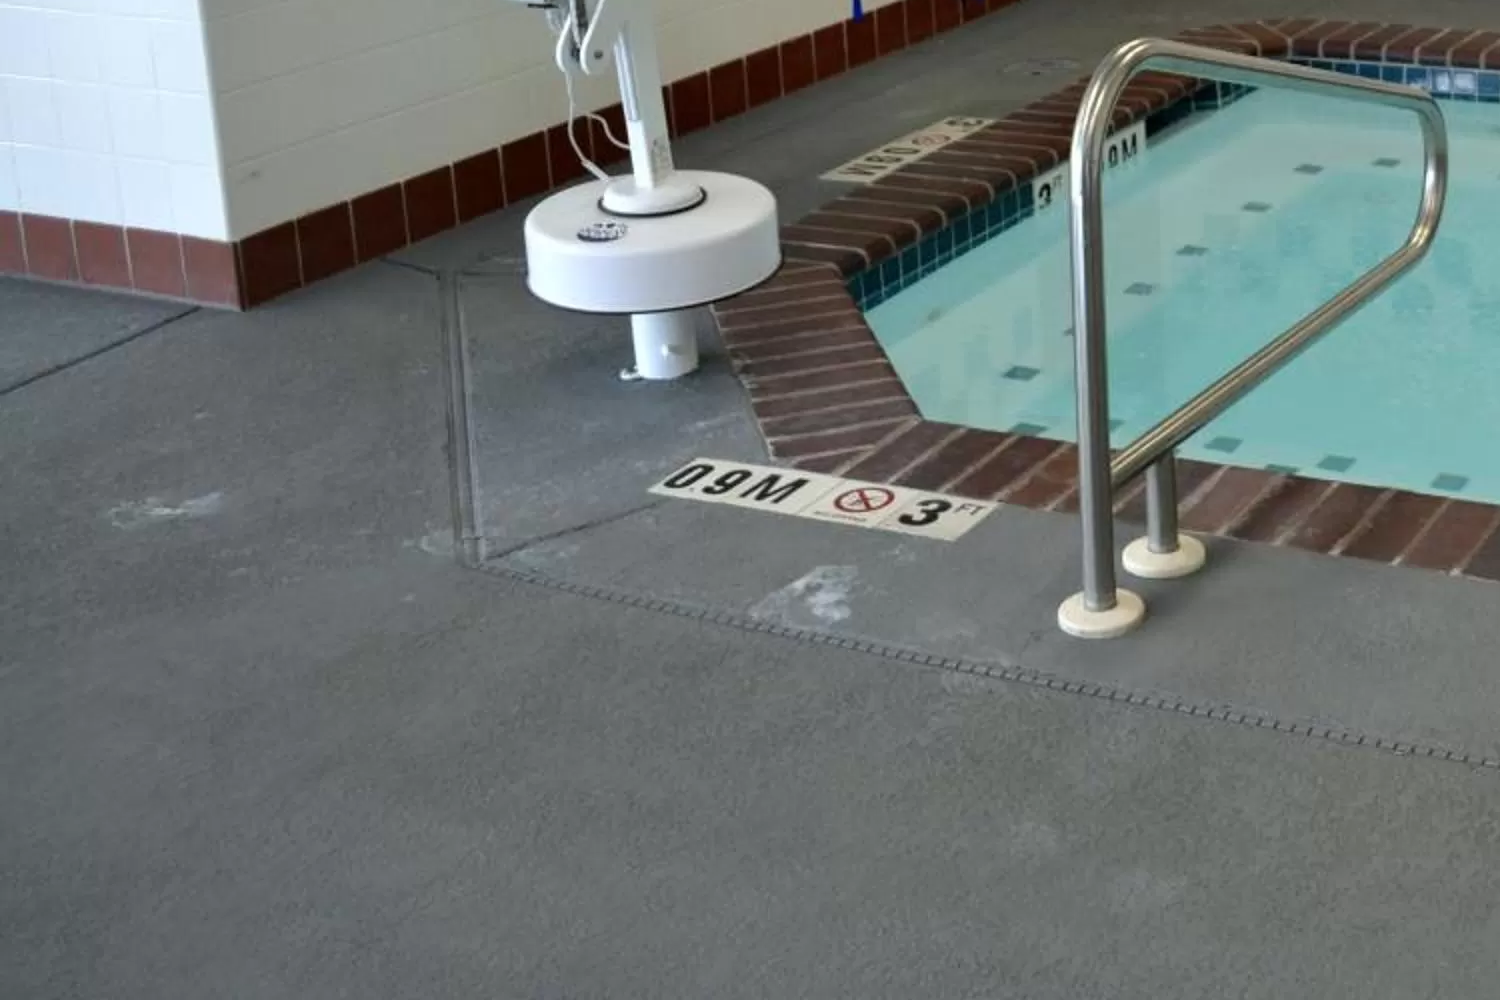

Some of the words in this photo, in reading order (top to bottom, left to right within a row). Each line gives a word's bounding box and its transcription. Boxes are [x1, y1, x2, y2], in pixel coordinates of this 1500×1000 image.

[1038, 183, 1052, 209] 3
[899, 499, 952, 526] 3
[954, 503, 986, 516] FT
